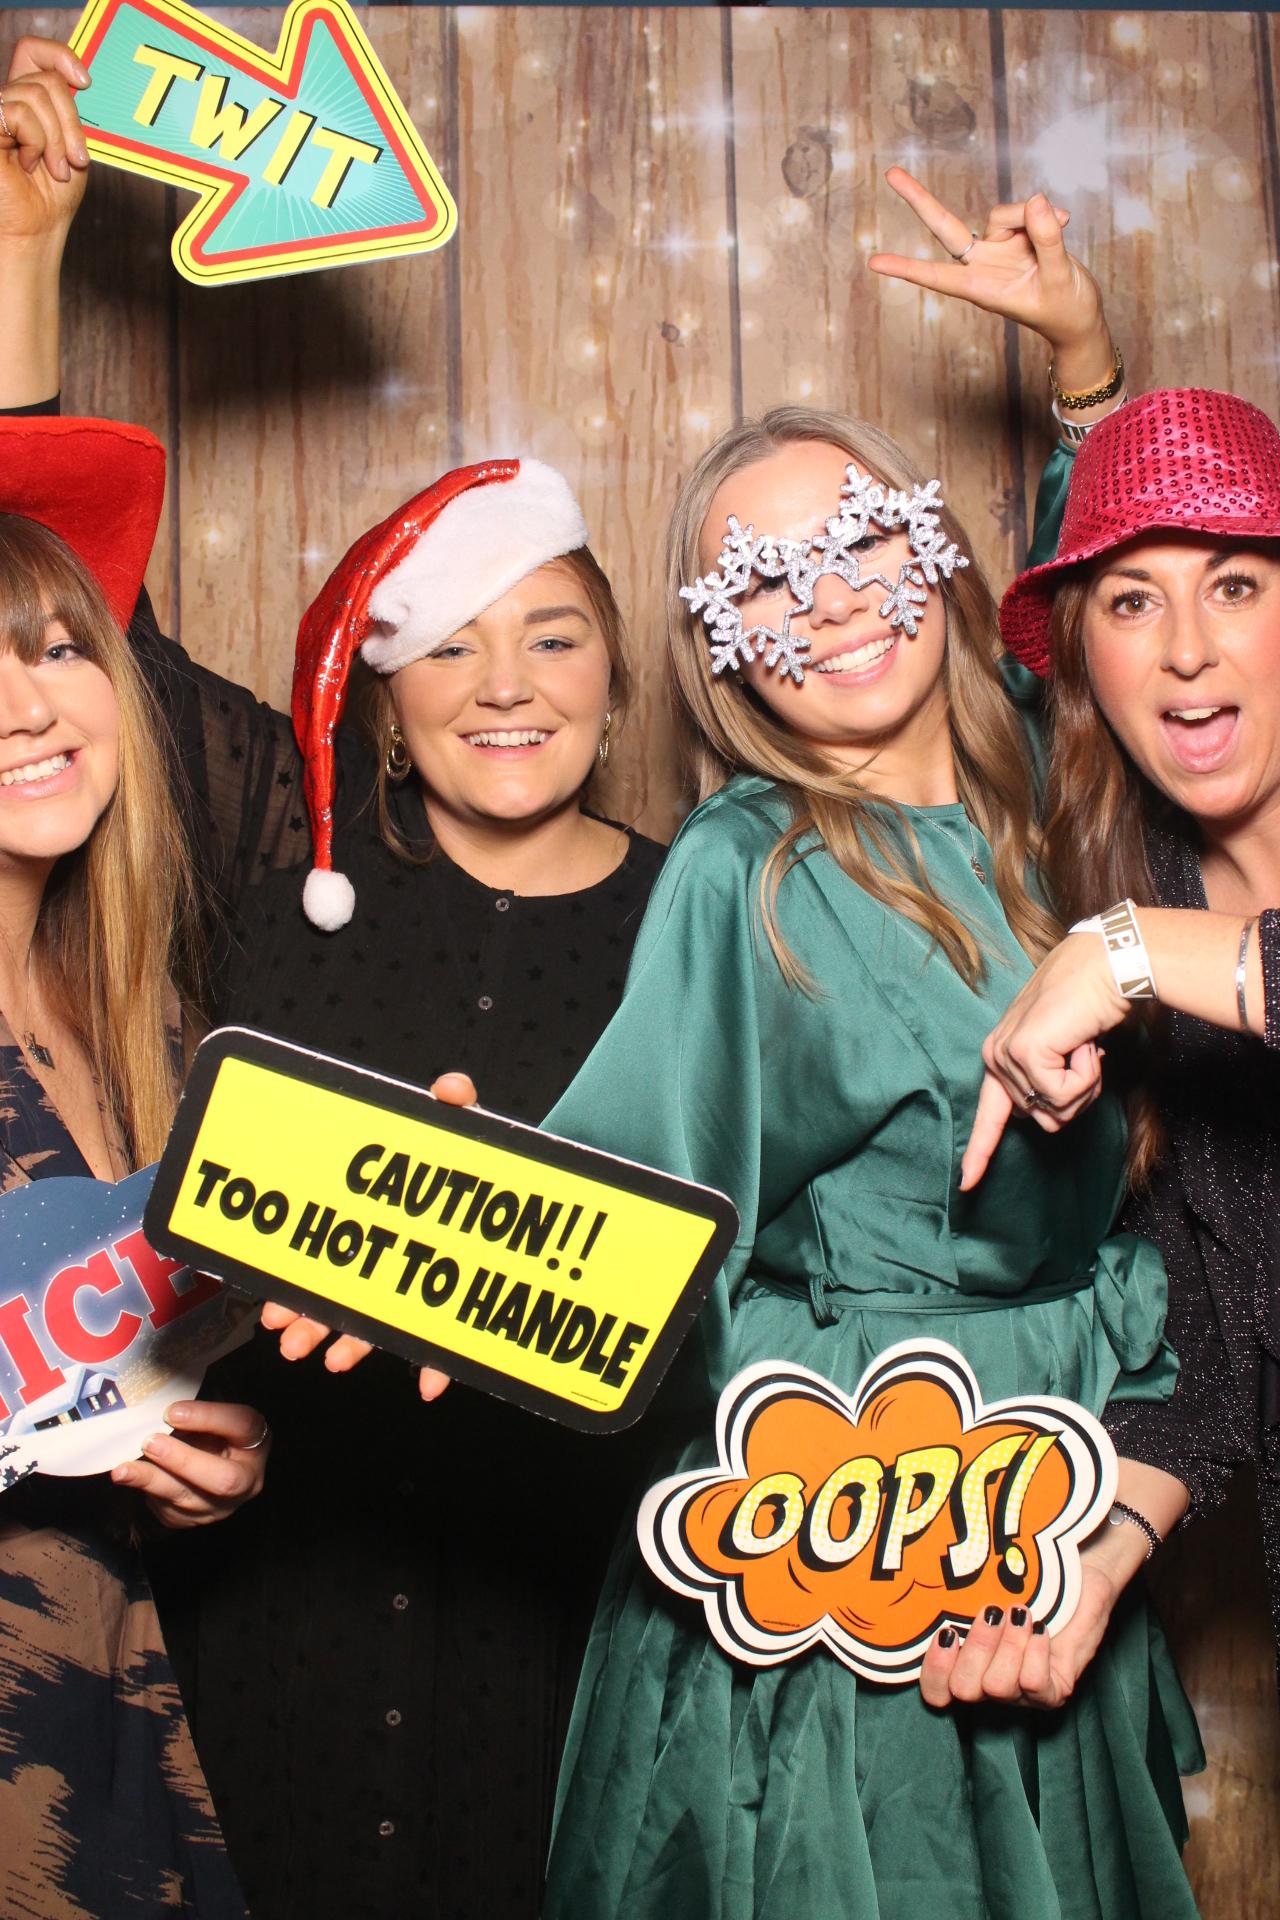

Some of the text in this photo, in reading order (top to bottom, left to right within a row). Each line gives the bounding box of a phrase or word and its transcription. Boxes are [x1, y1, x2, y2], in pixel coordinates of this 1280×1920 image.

[133, 44, 384, 209] TWIT
[194, 1160, 650, 1388] TOO HOT TO HANDLE
[345, 1144, 608, 1281] CAUTION!!
[0, 1227, 224, 1424] ICE
[718, 1431, 1062, 1594] OOPS!
